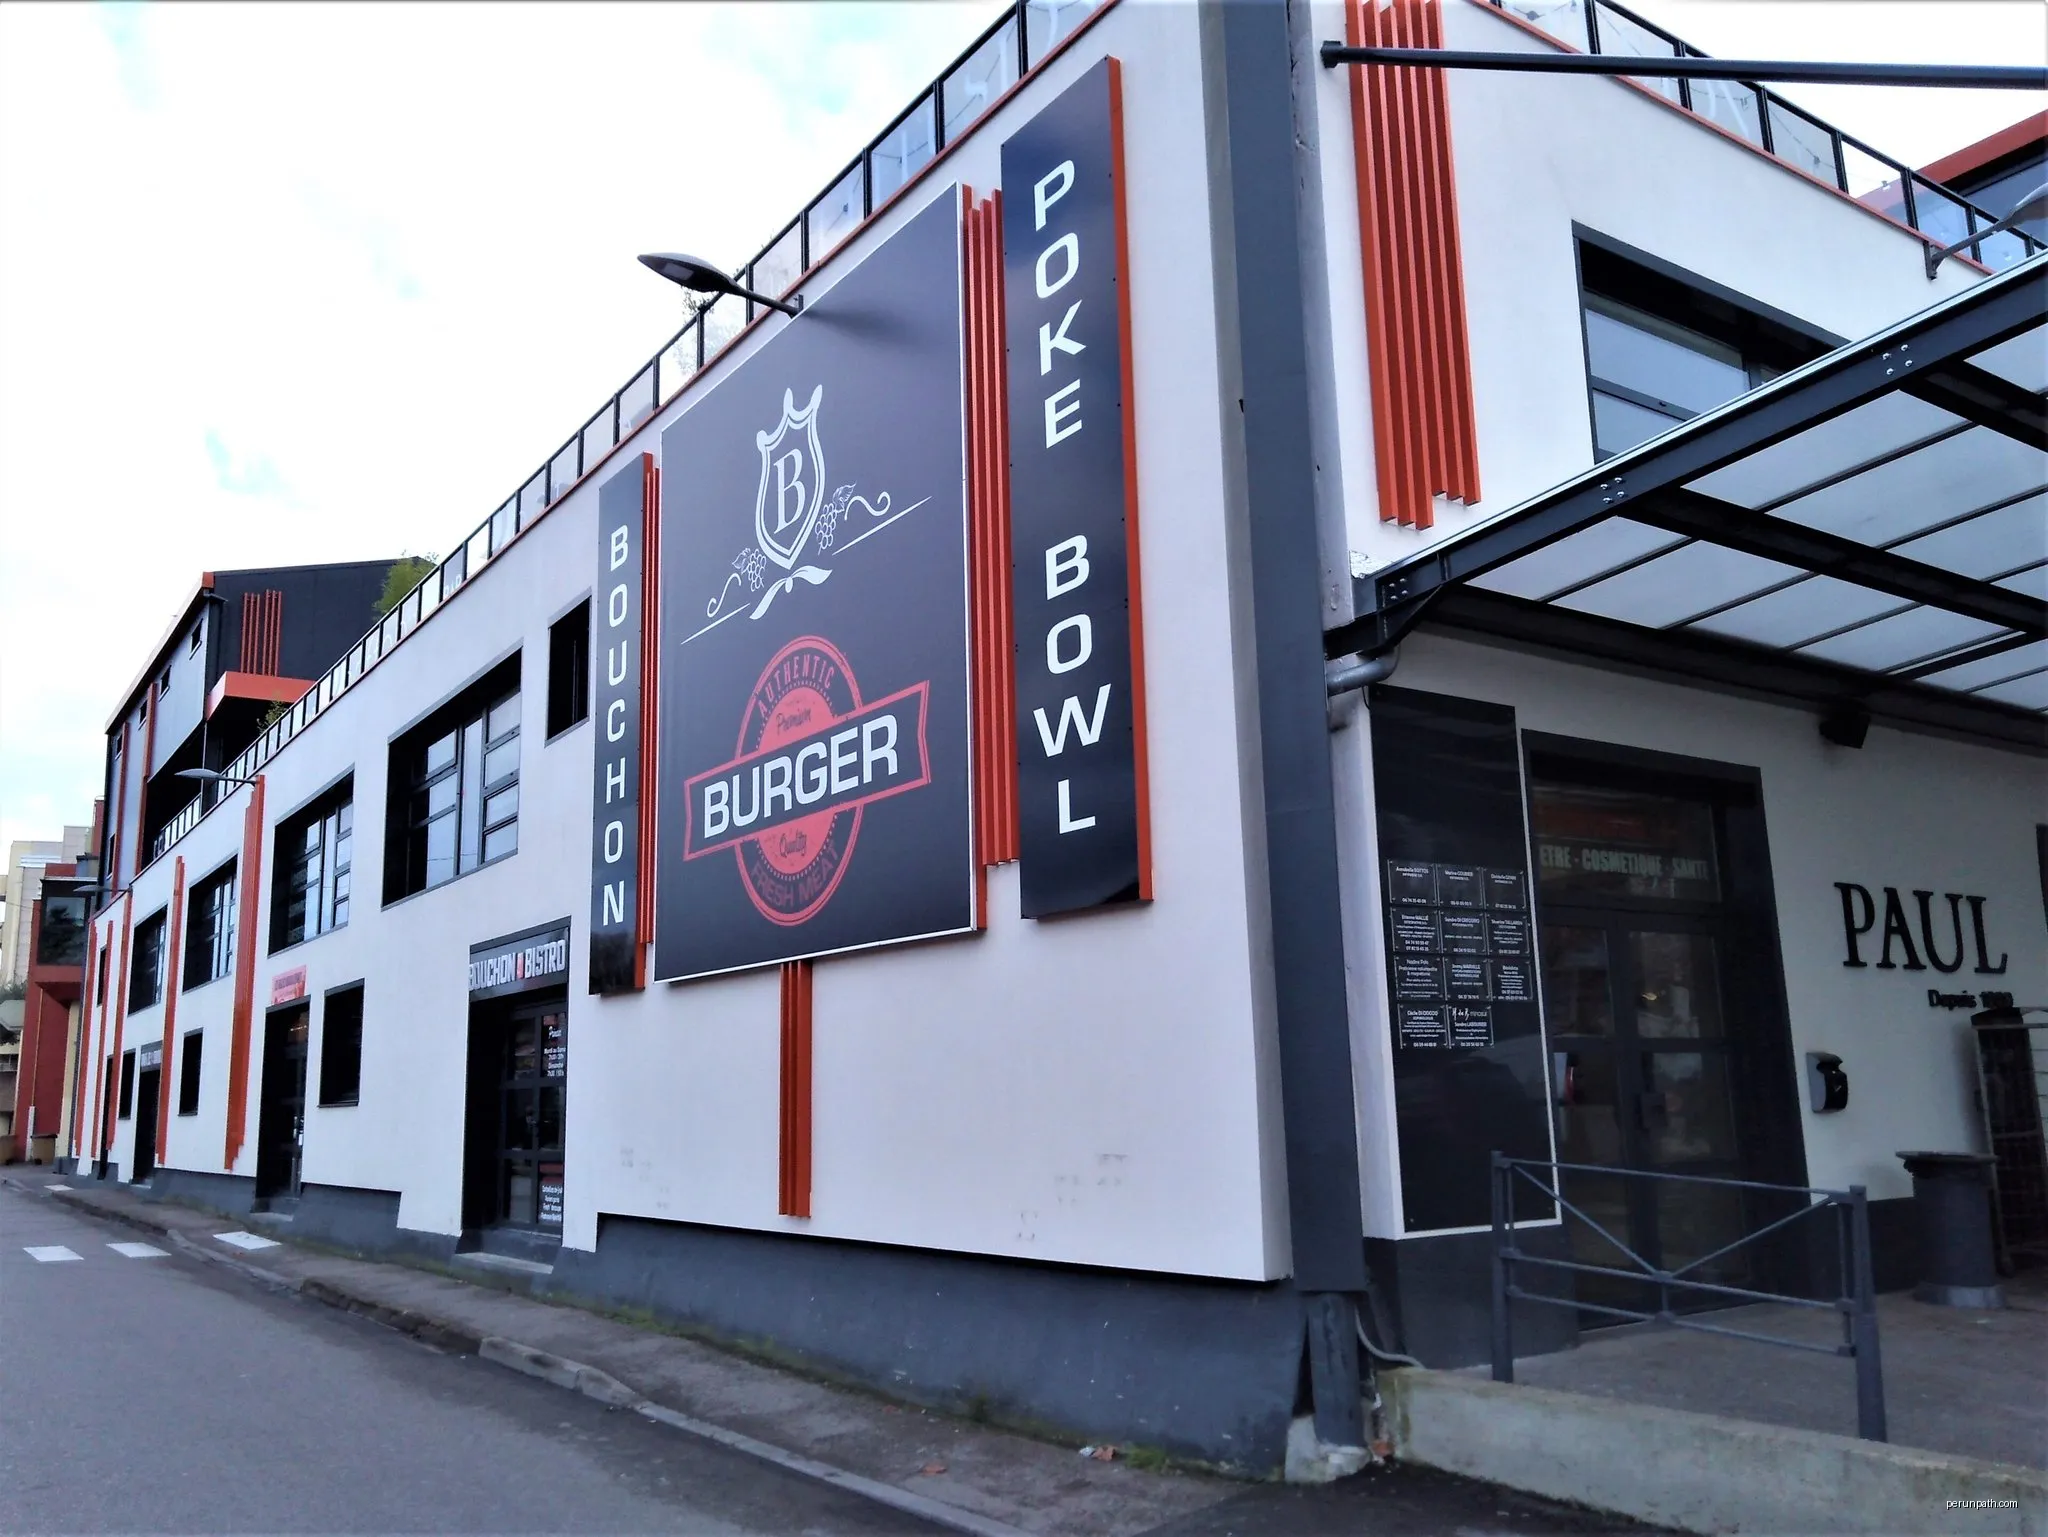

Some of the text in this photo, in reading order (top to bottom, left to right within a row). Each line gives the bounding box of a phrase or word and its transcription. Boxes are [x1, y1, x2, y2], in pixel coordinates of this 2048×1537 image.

[1033, 159, 1111, 835] POKE BOWL
[758, 654, 835, 718] AUTHENTIC
[603, 524, 628, 926] BOUCHON
[776, 708, 812, 736] Premium
[703, 713, 898, 839] BURGER
[750, 840, 838, 907] FRESH MEAT
[780, 829, 807, 858] Quality
[1833, 881, 2008, 974] PAUL
[469, 939, 565, 991] BOUCHON BISTRO
